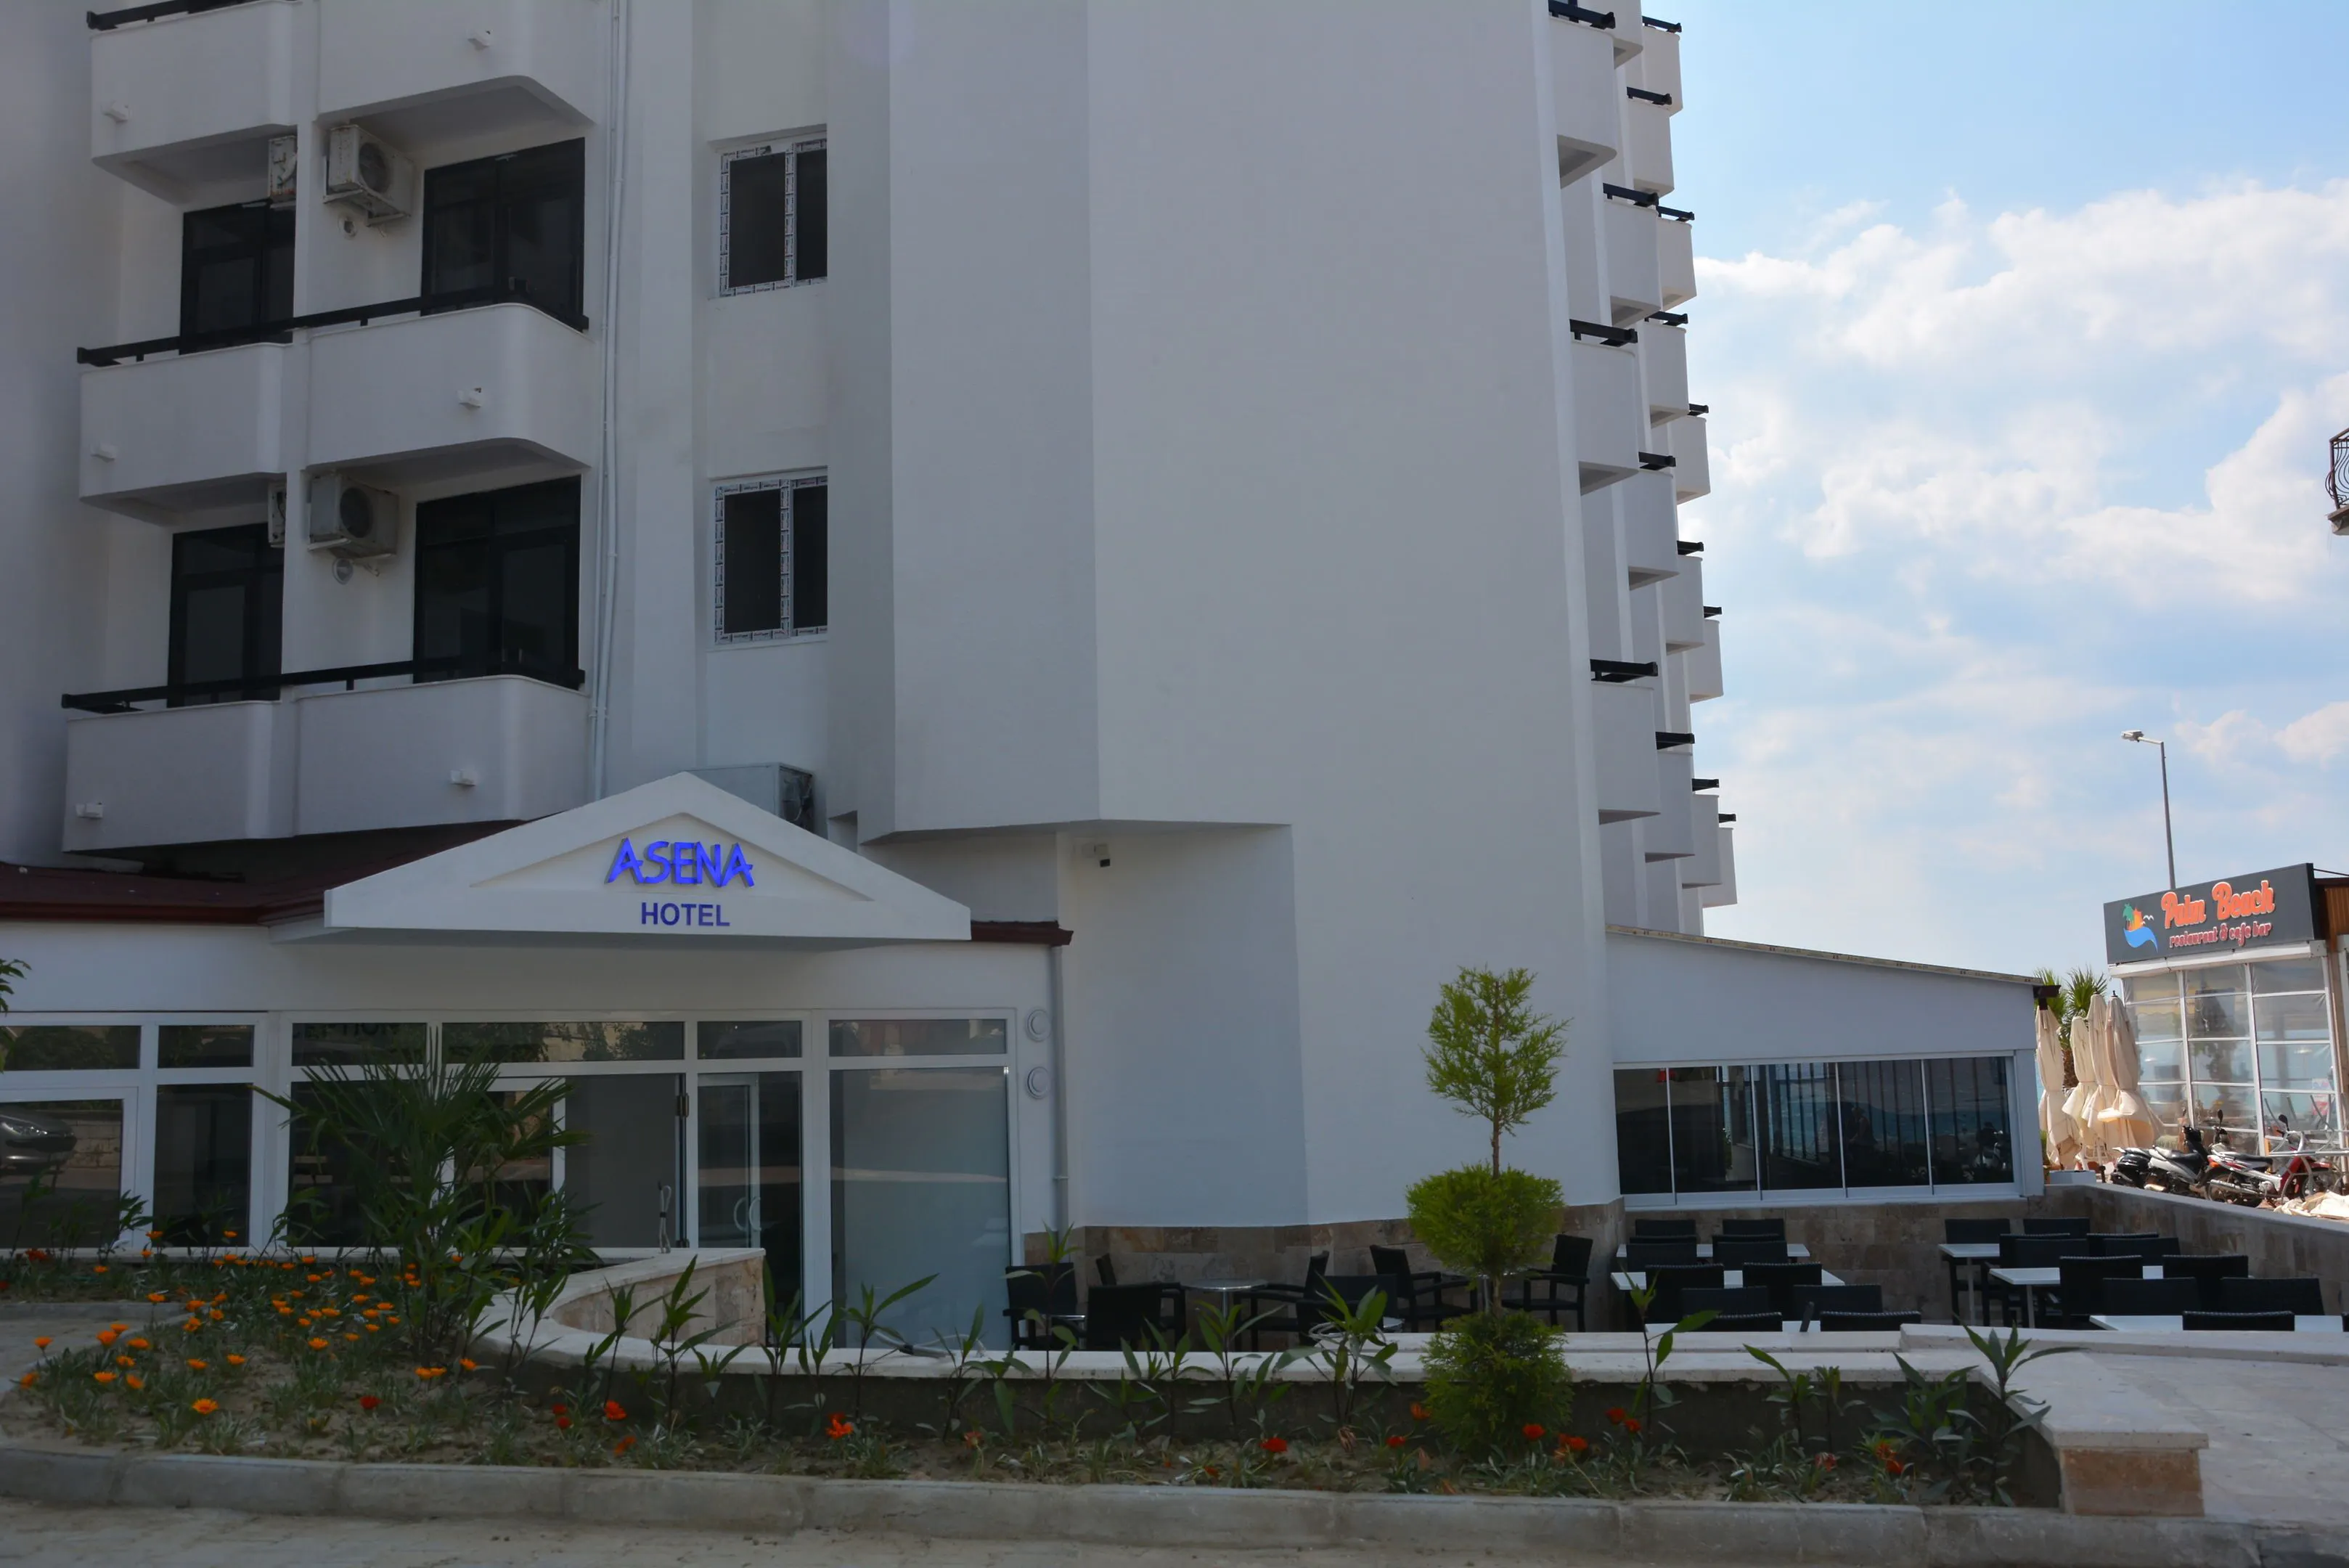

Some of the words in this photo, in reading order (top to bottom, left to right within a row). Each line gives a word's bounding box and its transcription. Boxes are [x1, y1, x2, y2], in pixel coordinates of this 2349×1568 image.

[605, 838, 755, 887] ASENA
[641, 902, 730, 926] HOTEL
[2161, 891, 2207, 929] Palm
[2212, 879, 2276, 920] Beach
[2169, 926, 2218, 948] restaurant
[2252, 921, 2271, 937] bar
